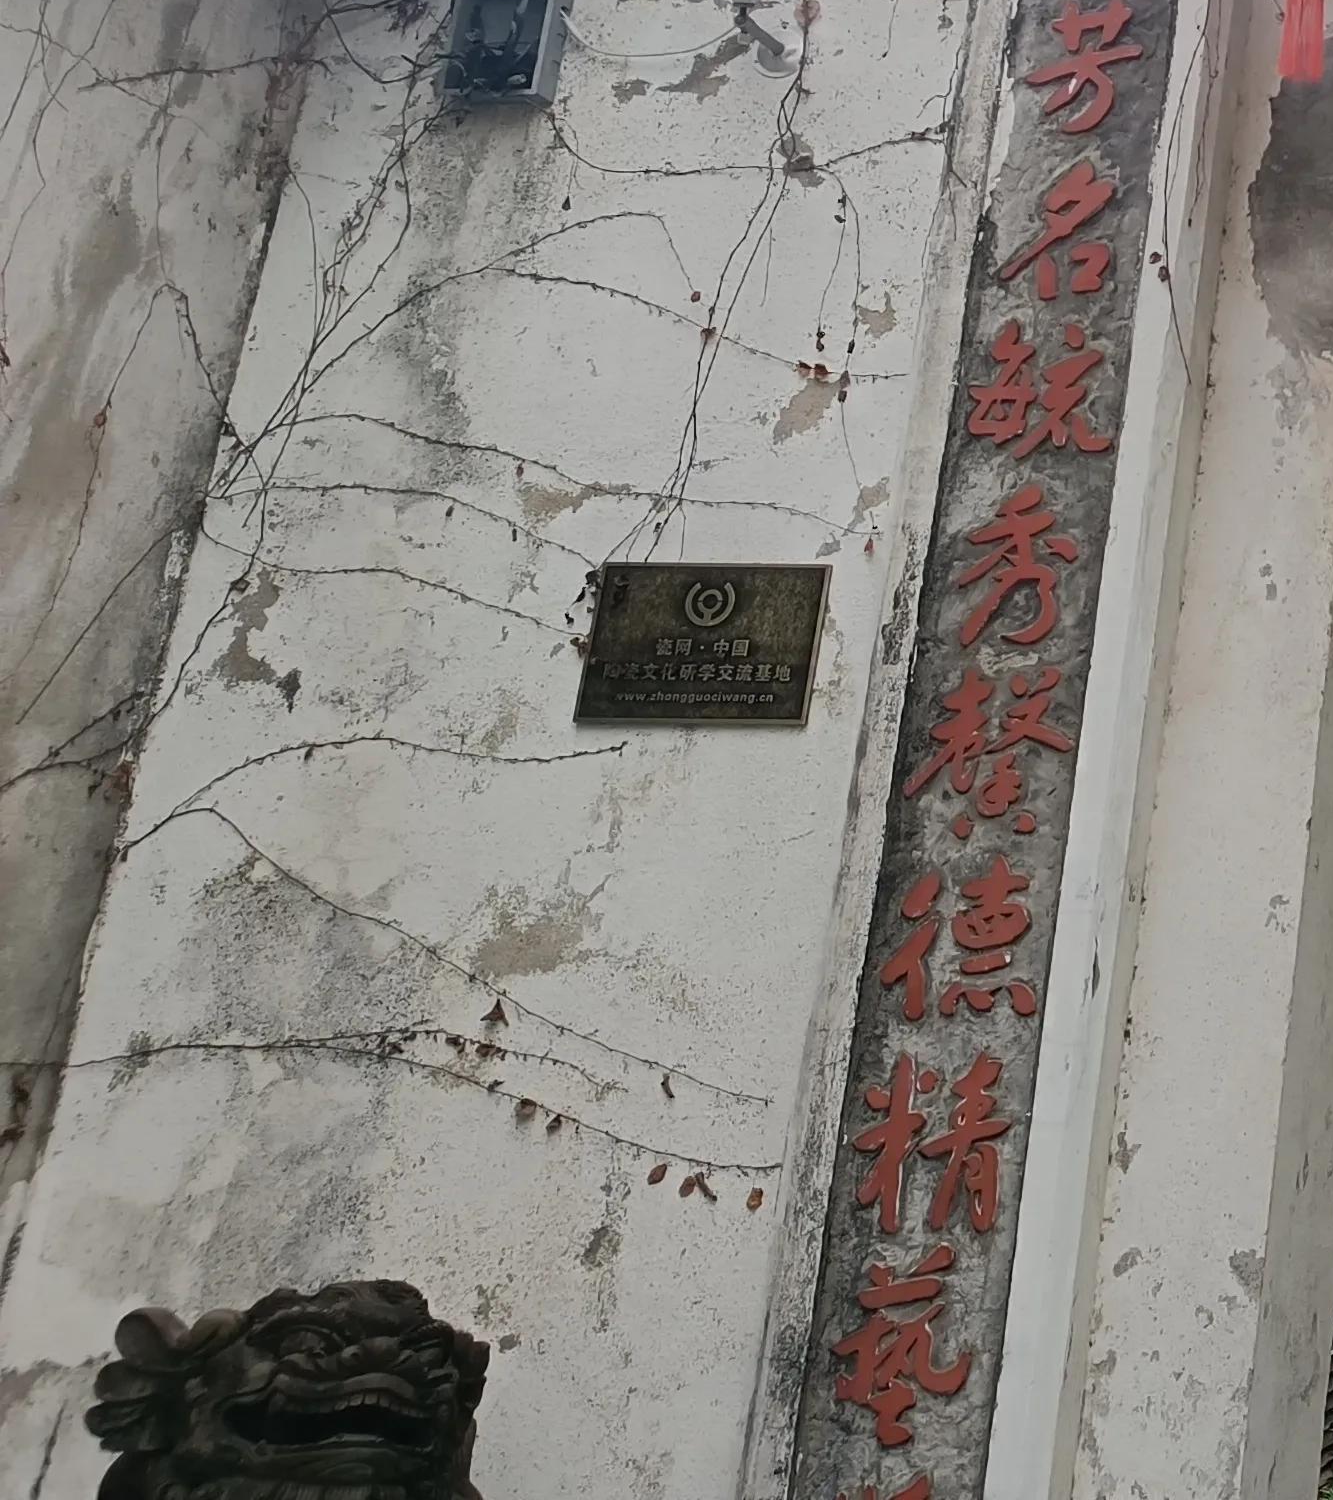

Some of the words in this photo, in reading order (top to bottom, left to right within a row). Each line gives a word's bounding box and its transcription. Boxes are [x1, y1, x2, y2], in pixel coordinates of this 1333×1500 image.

[602, 662, 792, 683] 陶瓷文化研学交流基地
[614, 690, 774, 705] www.zhongguociwang.cn
[831, 0, 1143, 1500] 芳名毓秀馨德精藝
